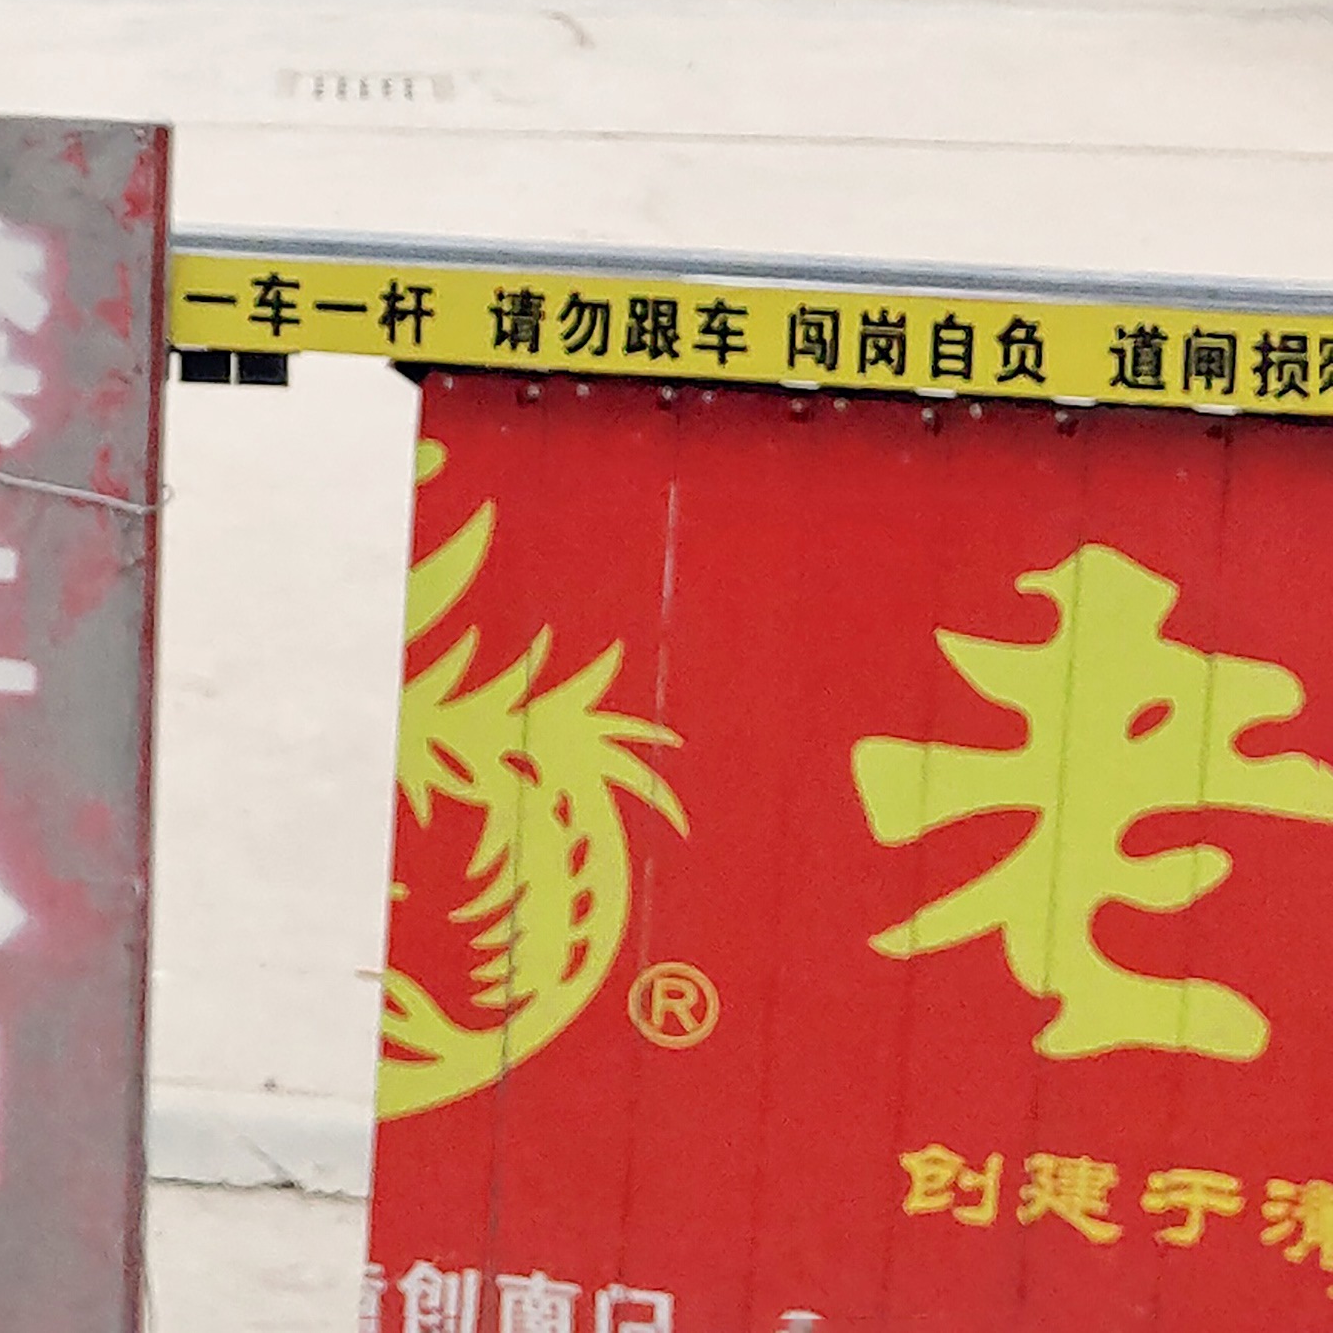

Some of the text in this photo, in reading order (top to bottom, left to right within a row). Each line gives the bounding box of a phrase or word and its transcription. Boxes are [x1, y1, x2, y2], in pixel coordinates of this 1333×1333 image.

[182, 270, 436, 347] 一车一杆
[488, 283, 750, 366] 请勿跟车
[785, 302, 1047, 384] 闯岗自负
[852, 543, 1333, 1059] 老
